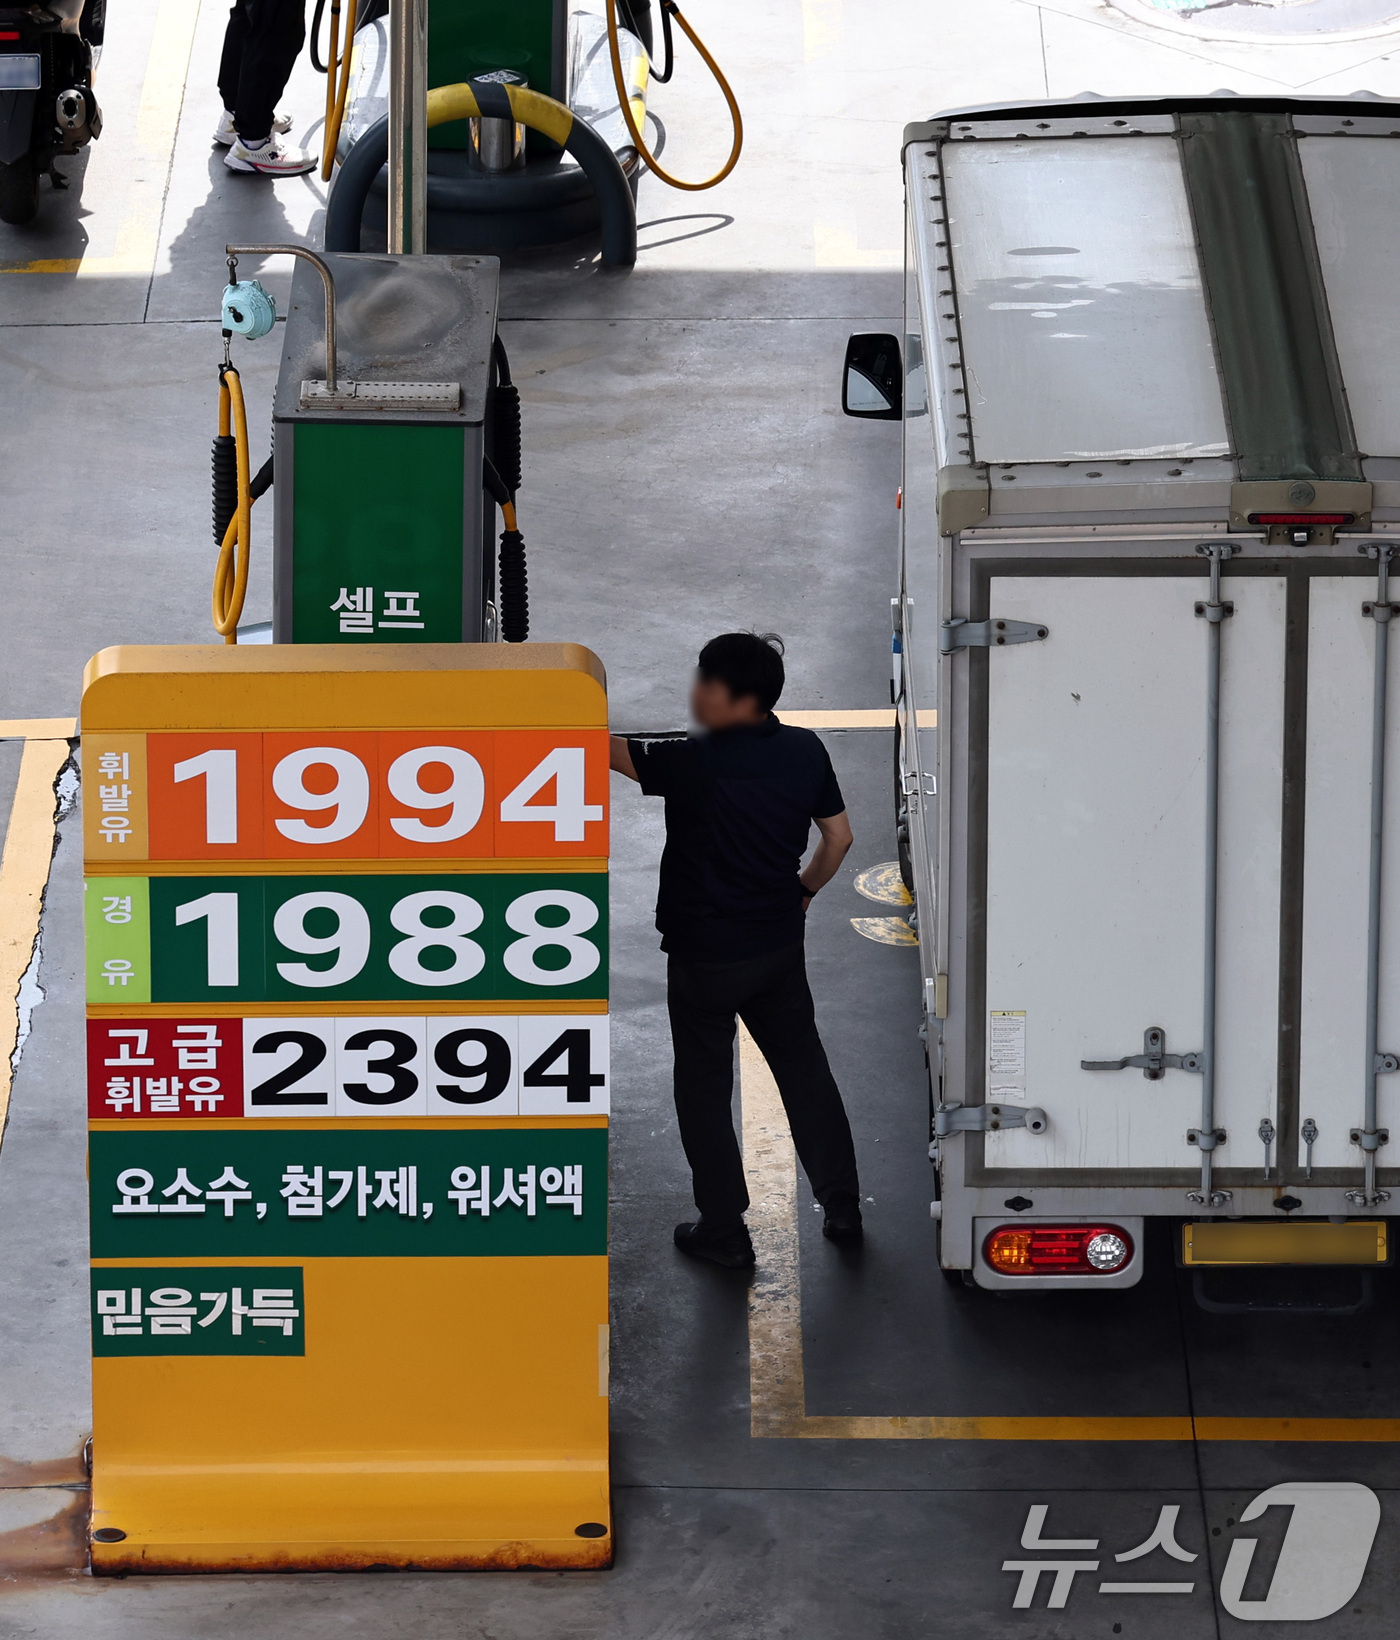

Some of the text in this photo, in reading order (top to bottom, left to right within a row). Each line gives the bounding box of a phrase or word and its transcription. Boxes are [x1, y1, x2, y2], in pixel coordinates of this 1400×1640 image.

[329, 586, 425, 634] 셀프
[98, 752, 133, 843] 휘발유
[173, 745, 604, 845] 1994
[101, 896, 135, 987] 경유
[175, 889, 601, 989] 1988
[105, 1076, 225, 1113] 휘발유
[250, 1028, 605, 1106] 2394
[111, 1164, 584, 1220] 요소수, 첨가제, 워셔액
[97, 1287, 300, 1336] 믿음가득
